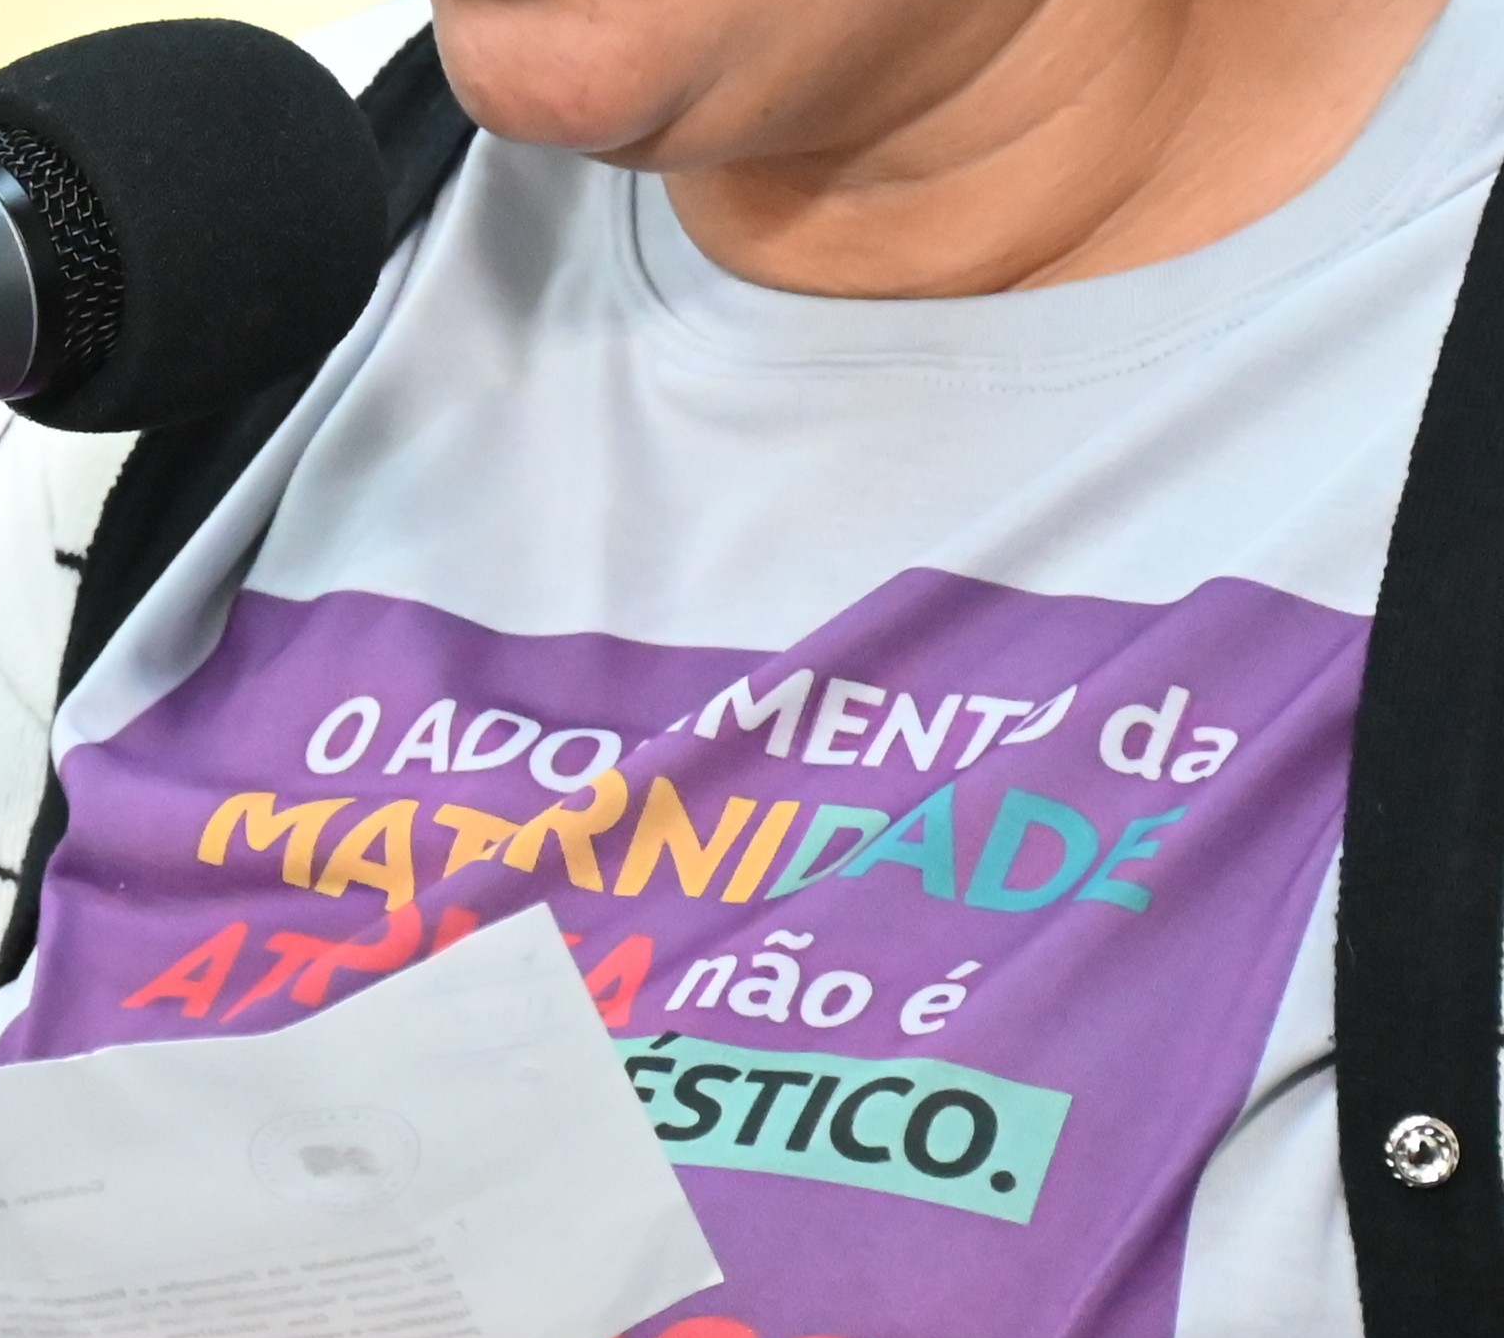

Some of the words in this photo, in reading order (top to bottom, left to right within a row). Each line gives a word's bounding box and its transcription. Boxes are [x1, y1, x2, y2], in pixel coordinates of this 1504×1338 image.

[305, 695, 382, 774] O
[1098, 687, 1239, 783] da
[665, 930, 874, 1029] não
[899, 961, 983, 1036] é
